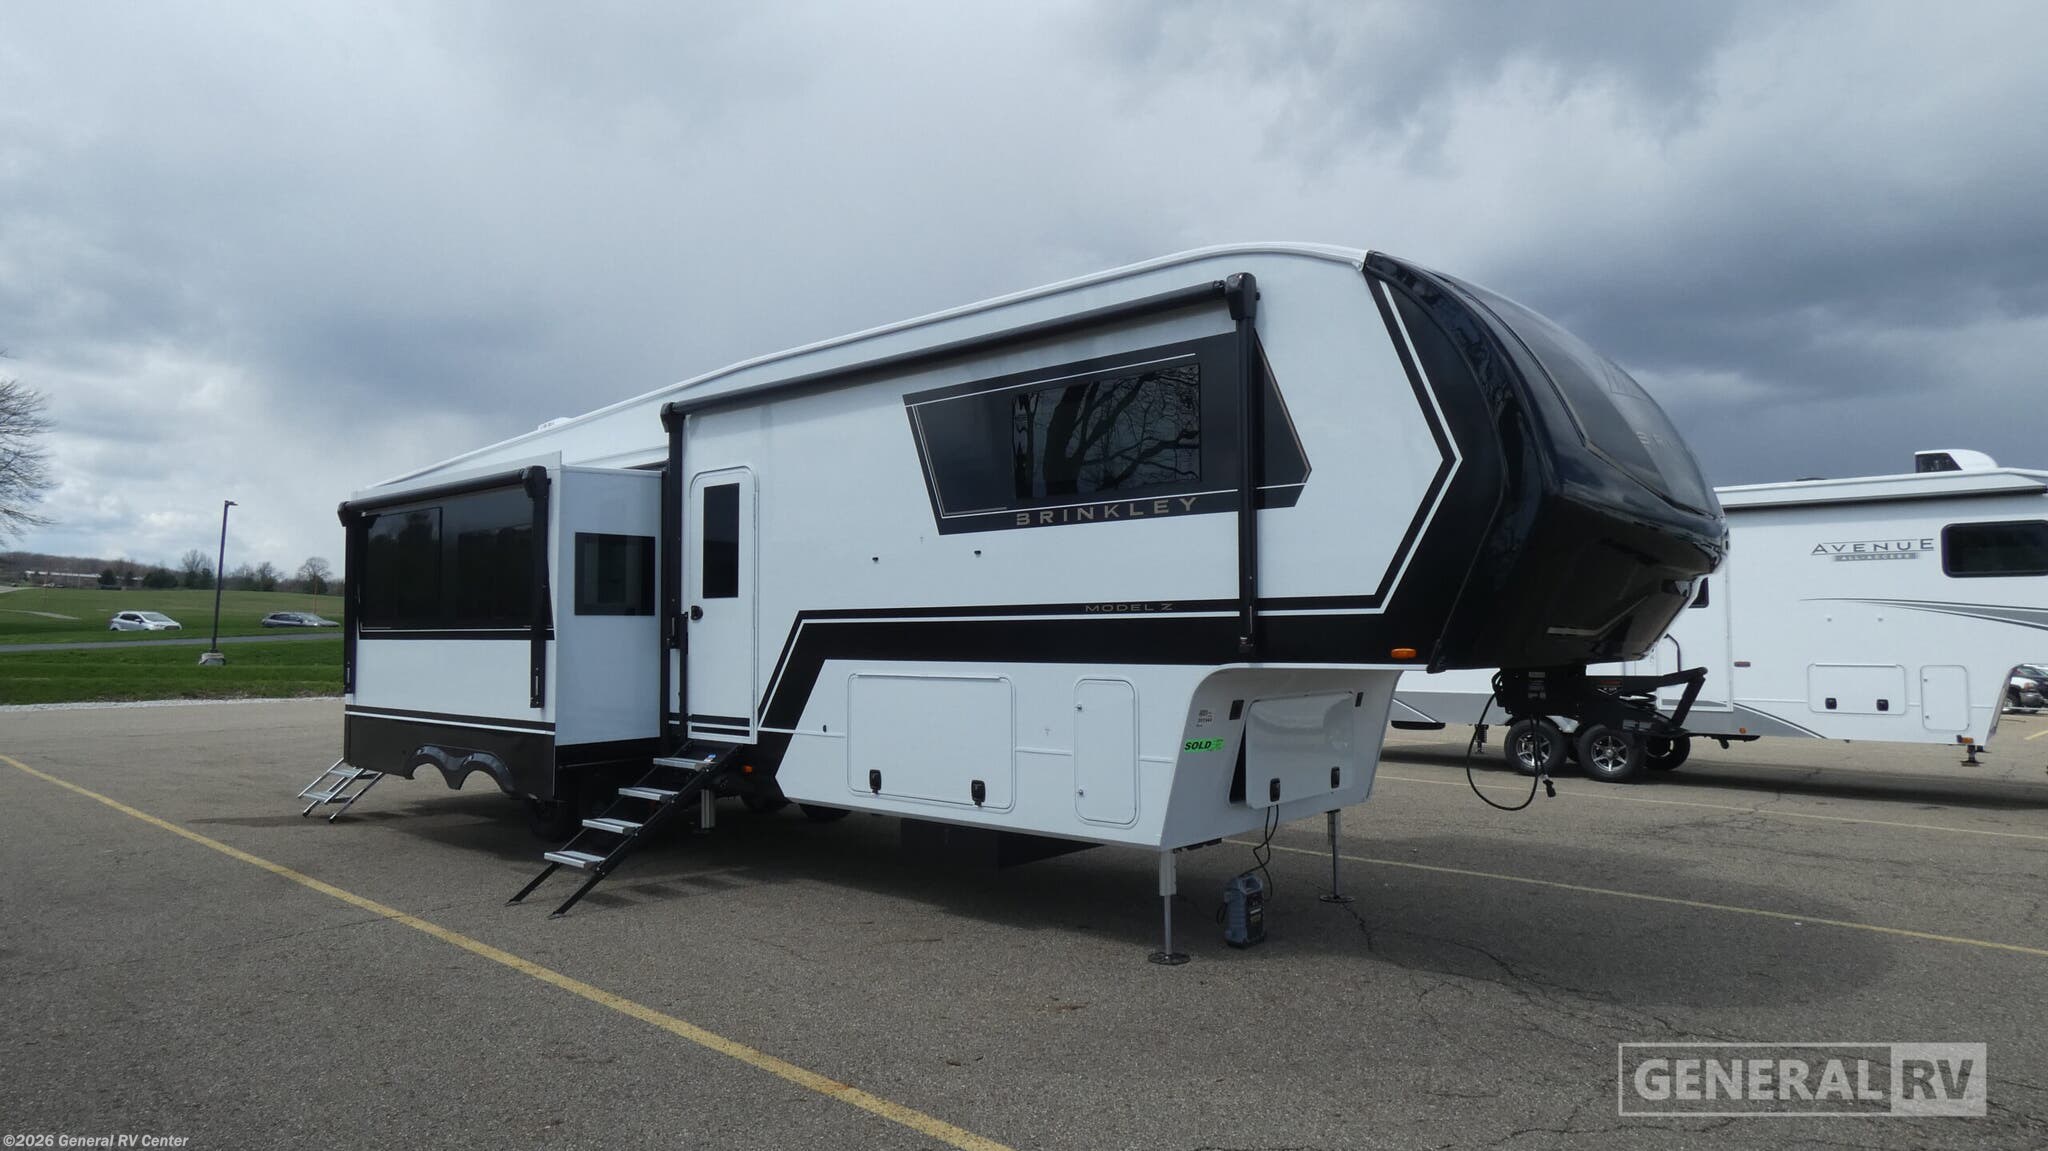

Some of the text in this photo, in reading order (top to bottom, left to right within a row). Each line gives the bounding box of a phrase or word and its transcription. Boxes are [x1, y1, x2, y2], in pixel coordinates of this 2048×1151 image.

[1016, 497, 1197, 526] BRINKLEY
[1811, 538, 1934, 554] AVENUE
[1085, 602, 1174, 613] MODEL Z
[1184, 740, 1212, 751] SOLD
